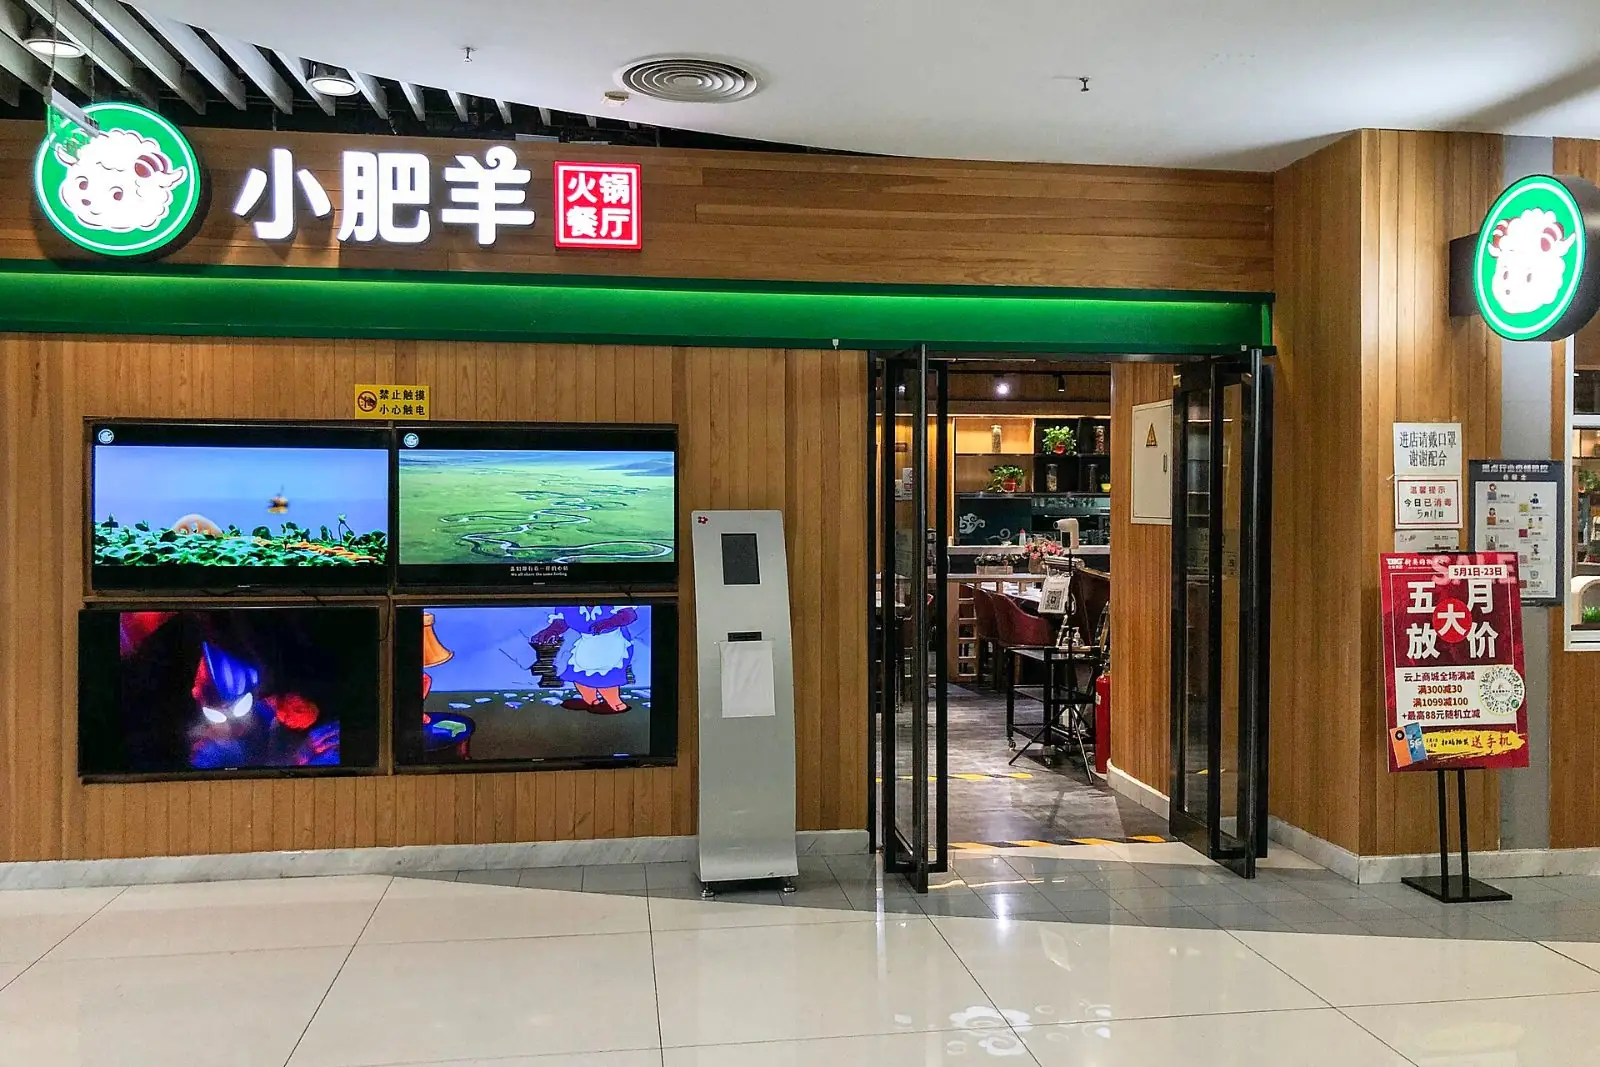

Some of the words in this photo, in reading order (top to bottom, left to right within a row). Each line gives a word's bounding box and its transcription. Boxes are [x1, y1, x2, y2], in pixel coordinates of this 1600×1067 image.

[566, 172, 632, 204] 火锅
[234, 146, 535, 244] 小肥羊
[566, 205, 631, 238] 餐厅
[379, 389, 425, 400] 禁止触摸
[379, 404, 426, 416] 小心触电
[1399, 431, 1457, 448] 进店请戴口罩
[1409, 450, 1447, 468] 谢谢配合
[1410, 486, 1446, 494] 温馨提示
[1404, 498, 1453, 508] 今日已消毒
[1453, 566, 1502, 577] 5月1日-23日
[1437, 604, 1466, 636] 大
[1403, 671, 1476, 682] 云上商城全场满减
[1417, 685, 1463, 695] 满300减30
[1412, 697, 1469, 707] 满1099减100
